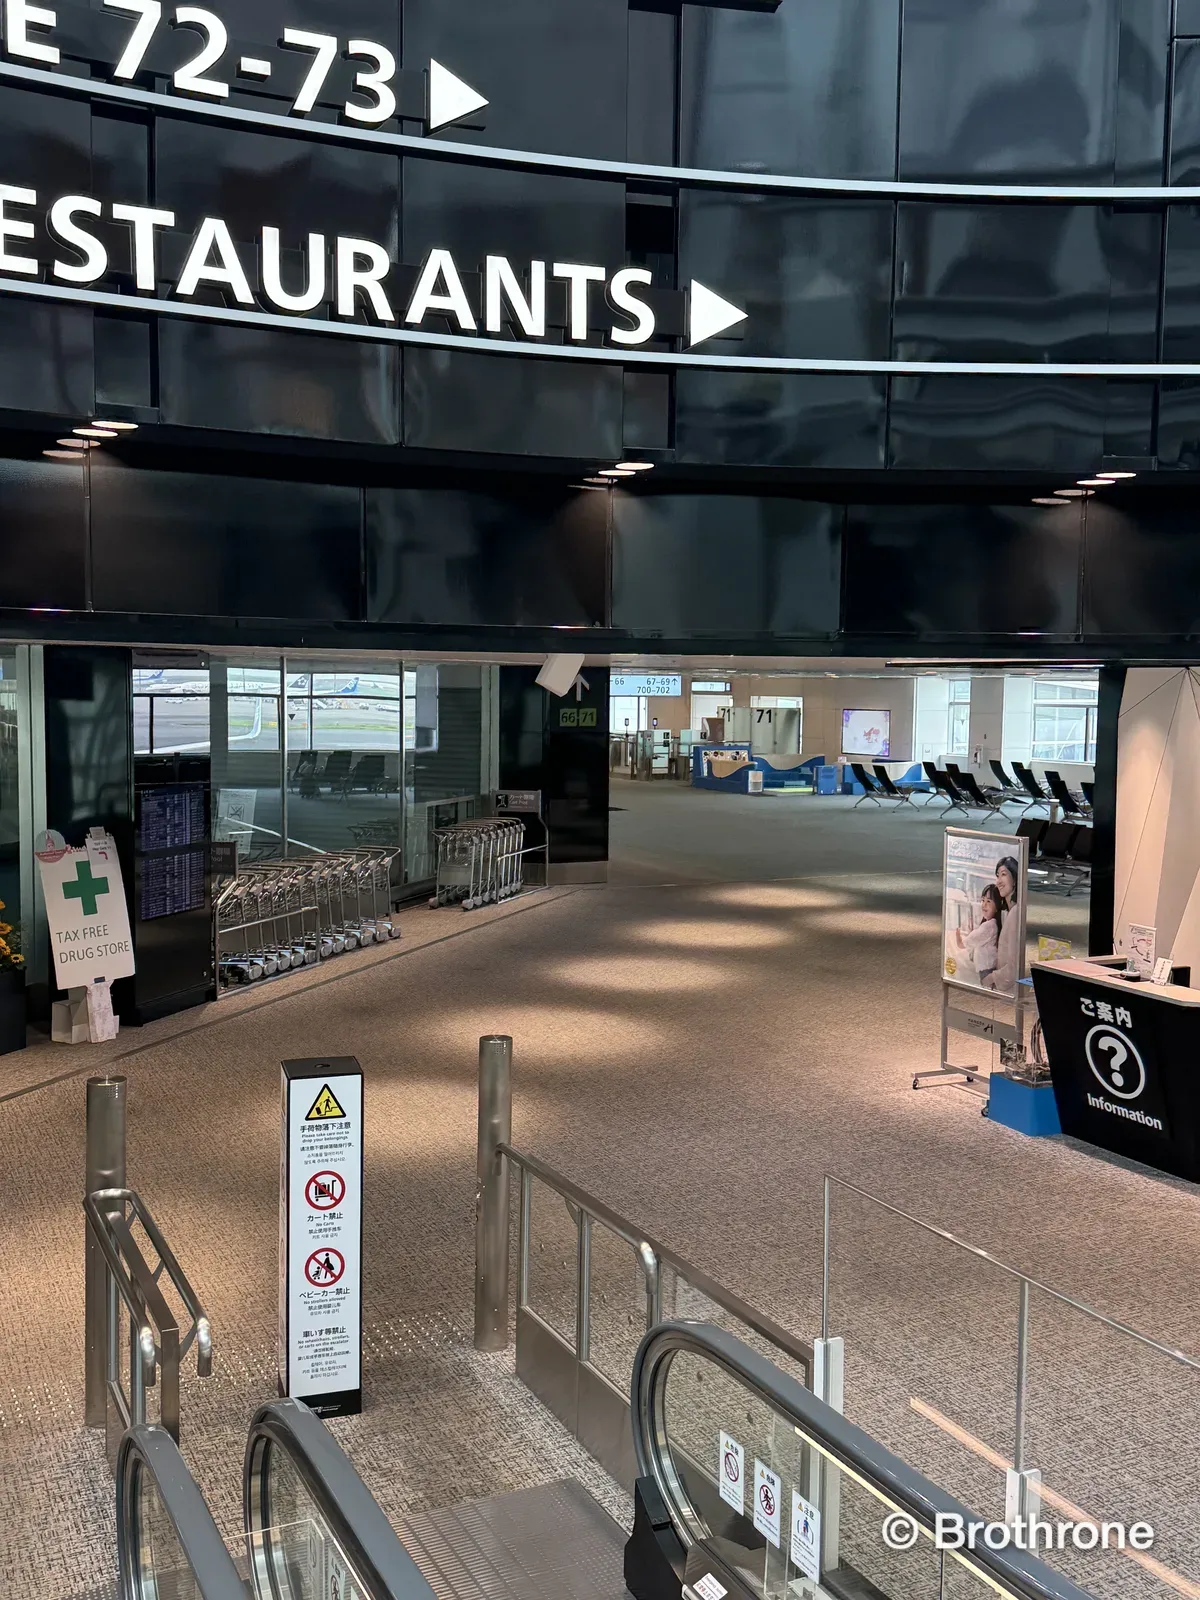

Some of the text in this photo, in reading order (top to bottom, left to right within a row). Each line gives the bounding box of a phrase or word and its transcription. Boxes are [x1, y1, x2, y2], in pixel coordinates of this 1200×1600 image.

[103, 0, 398, 124] 72-73
[0, 184, 656, 346] ESTAURANTS
[646, 677, 671, 686] 67-69
[636, 686, 671, 694] 700-702
[720, 708, 731, 722] 71
[756, 709, 772, 723] 71
[56, 924, 109, 944] TAX FREE
[59, 940, 130, 964] DRUG STORE
[1080, 997, 1133, 1028] ご案内
[1086, 1092, 1163, 1130] Information
[300, 1121, 352, 1134] 手荷物落下注意
[307, 1211, 344, 1222] カート禁止
[299, 1286, 351, 1299] ベビーカー禁止
[302, 1325, 347, 1338] 車いす等禁止
